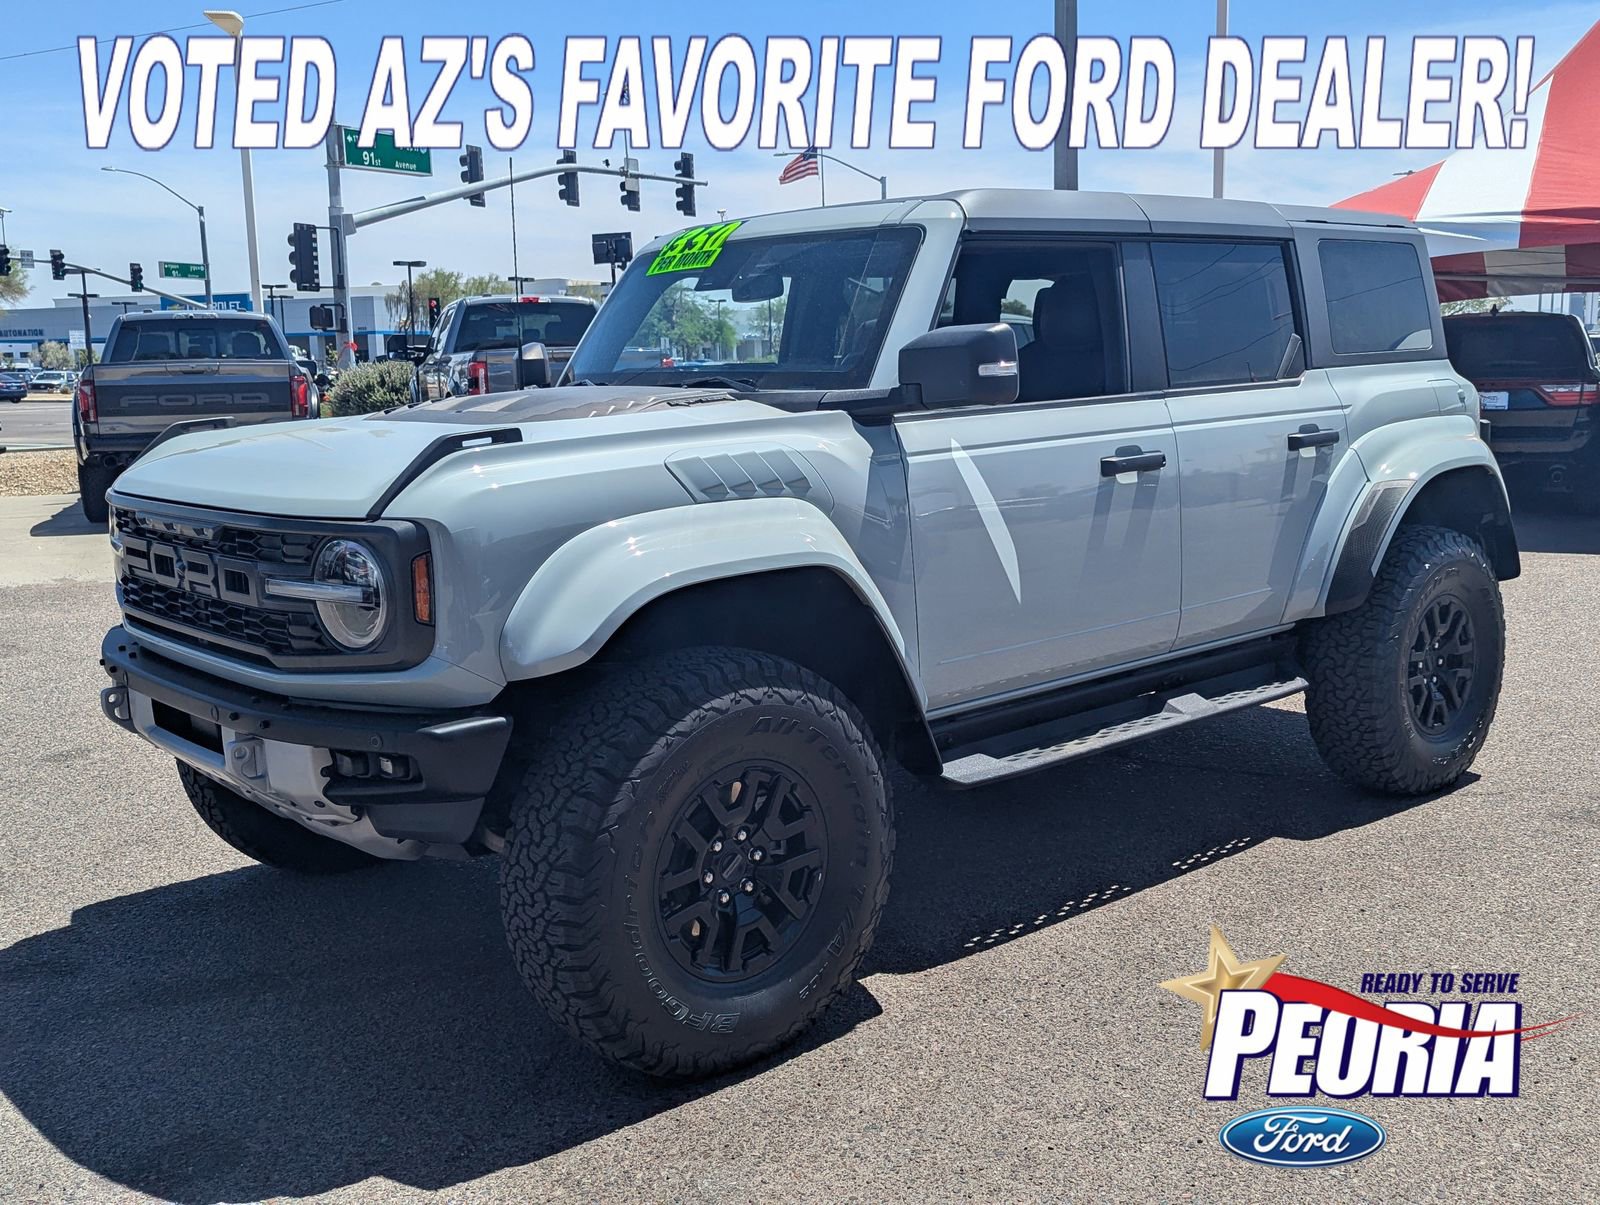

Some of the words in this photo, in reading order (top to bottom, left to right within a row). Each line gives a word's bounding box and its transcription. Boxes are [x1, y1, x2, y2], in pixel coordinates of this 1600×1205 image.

[362, 151, 381, 166] 91st
[395, 160, 416, 170] Avenue
[652, 256, 674, 272] PER
[673, 250, 715, 269] MONTH
[120, 393, 269, 408] FORD
[122, 536, 259, 606] FORD
